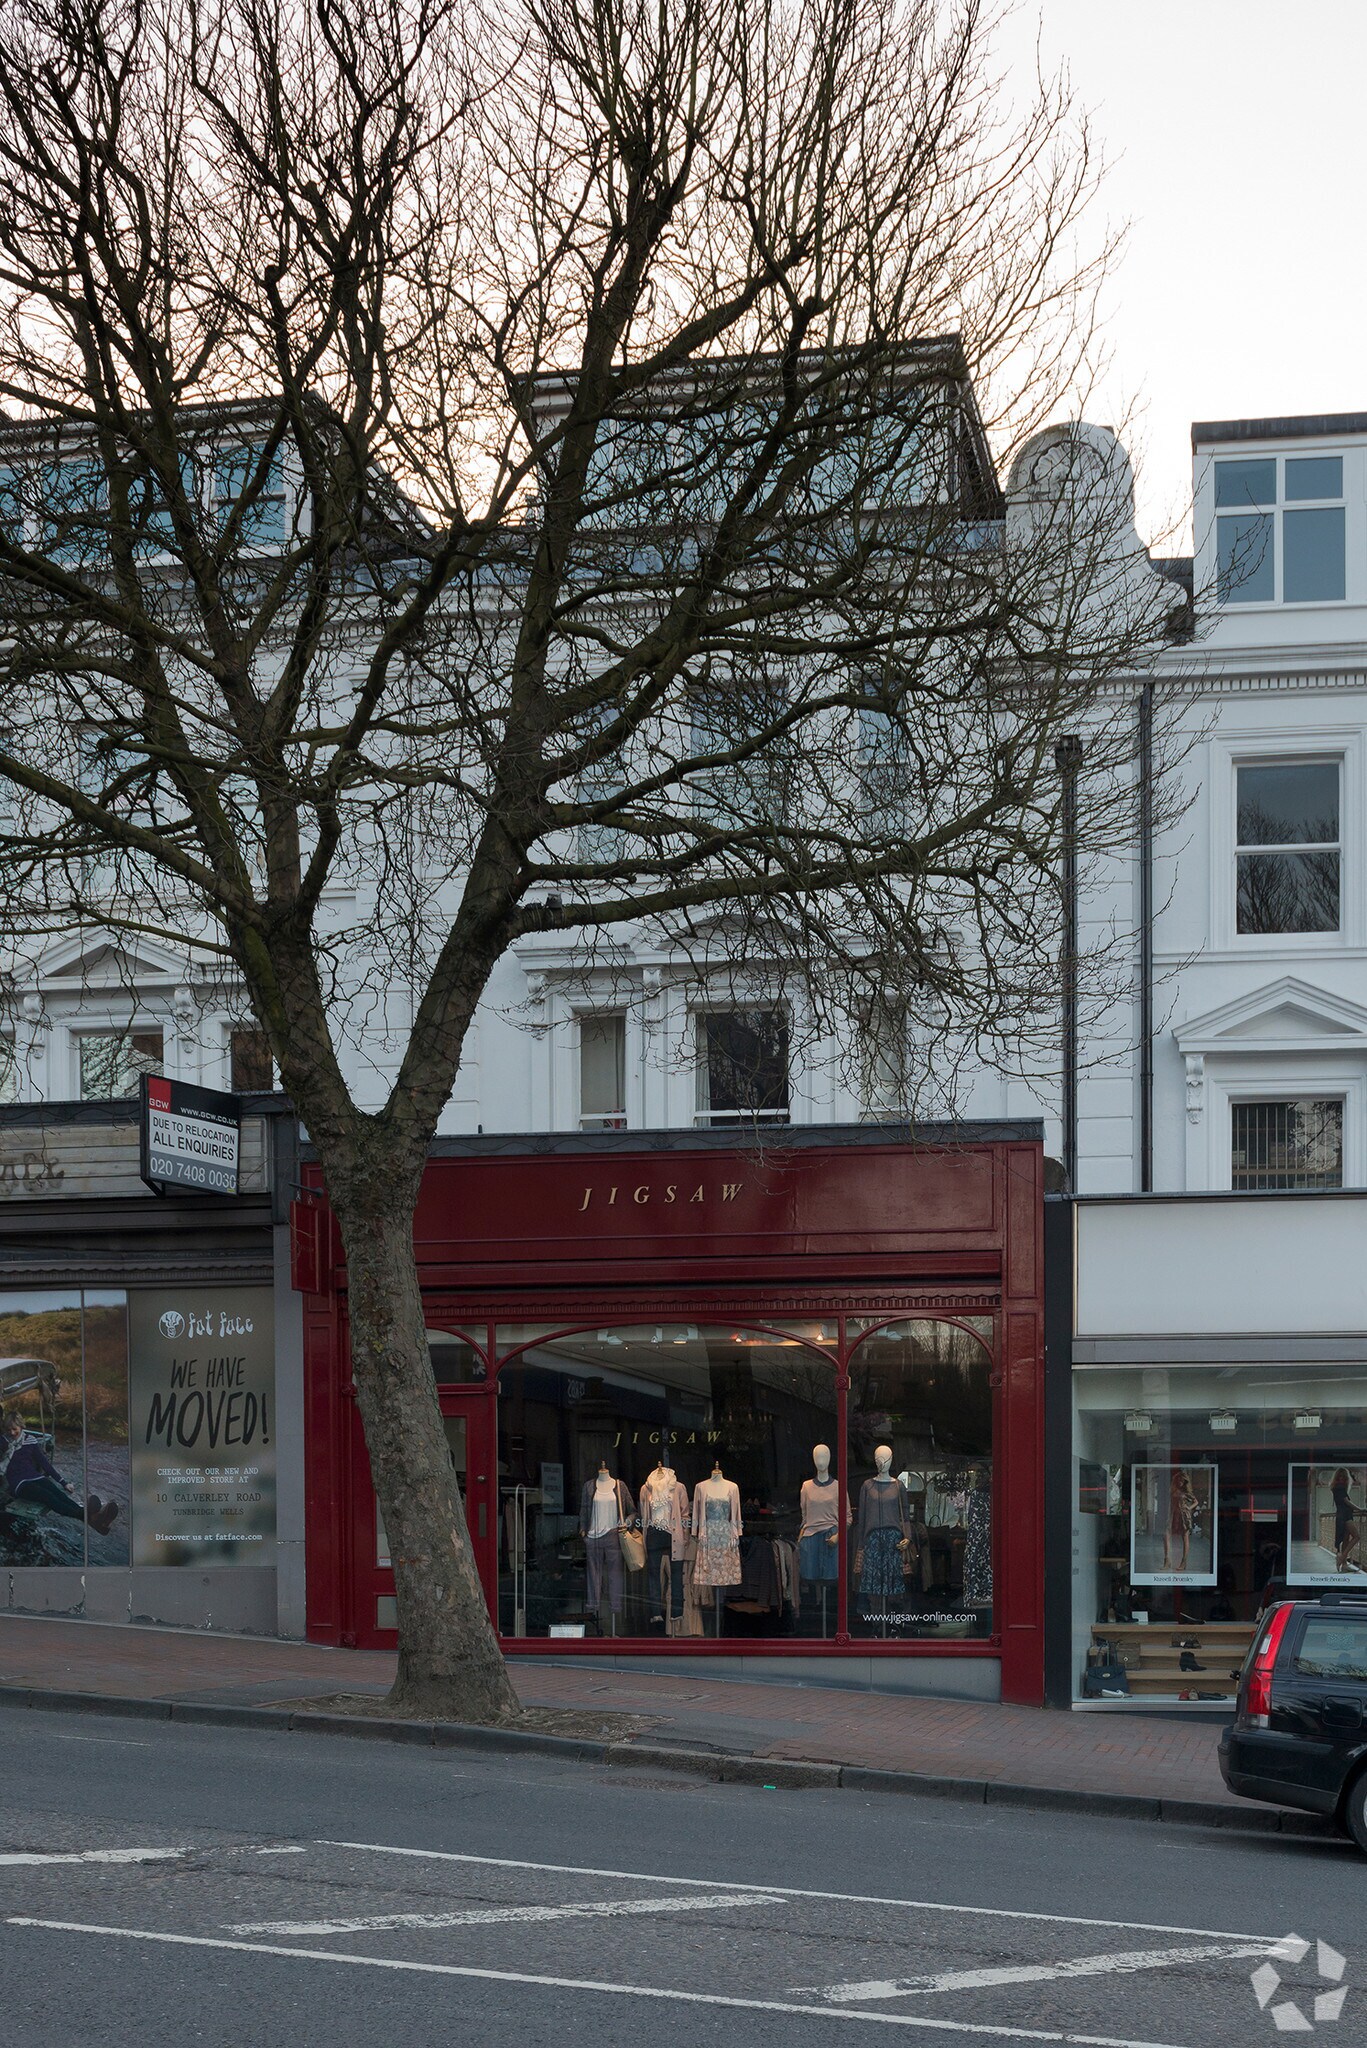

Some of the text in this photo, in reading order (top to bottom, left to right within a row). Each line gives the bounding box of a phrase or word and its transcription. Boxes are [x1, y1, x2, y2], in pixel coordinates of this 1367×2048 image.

[148, 1097, 170, 1110] GCW
[153, 1116, 236, 1145] DUE TO RELOCATION
[153, 1131, 234, 1161] ALL ENQUIRIES
[149, 1156, 237, 1190] 020 7408 0030
[578, 1183, 743, 1212] JIGSAW
[188, 1310, 254, 1338] fat face
[170, 1356, 247, 1388] WE HAVE
[146, 1390, 270, 1449] MOVED!
[612, 1431, 721, 1448] JIGSAW
[156, 1468, 181, 1476] CHECK
[205, 1467, 220, 1475] OUR
[224, 1467, 240, 1475] NEW
[243, 1467, 259, 1475] AND
[167, 1476, 206, 1484] IMPROVED
[156, 1492, 262, 1503] 10 CALVERLEY ROAD
[172, 1508, 244, 1516] TUNBRIDGE WELLS
[155, 1533, 190, 1541] Discover
[204, 1533, 213, 1541] at
[215, 1533, 263, 1541] fatface.com
[862, 1611, 977, 1625] www.jigsaw-online.com
